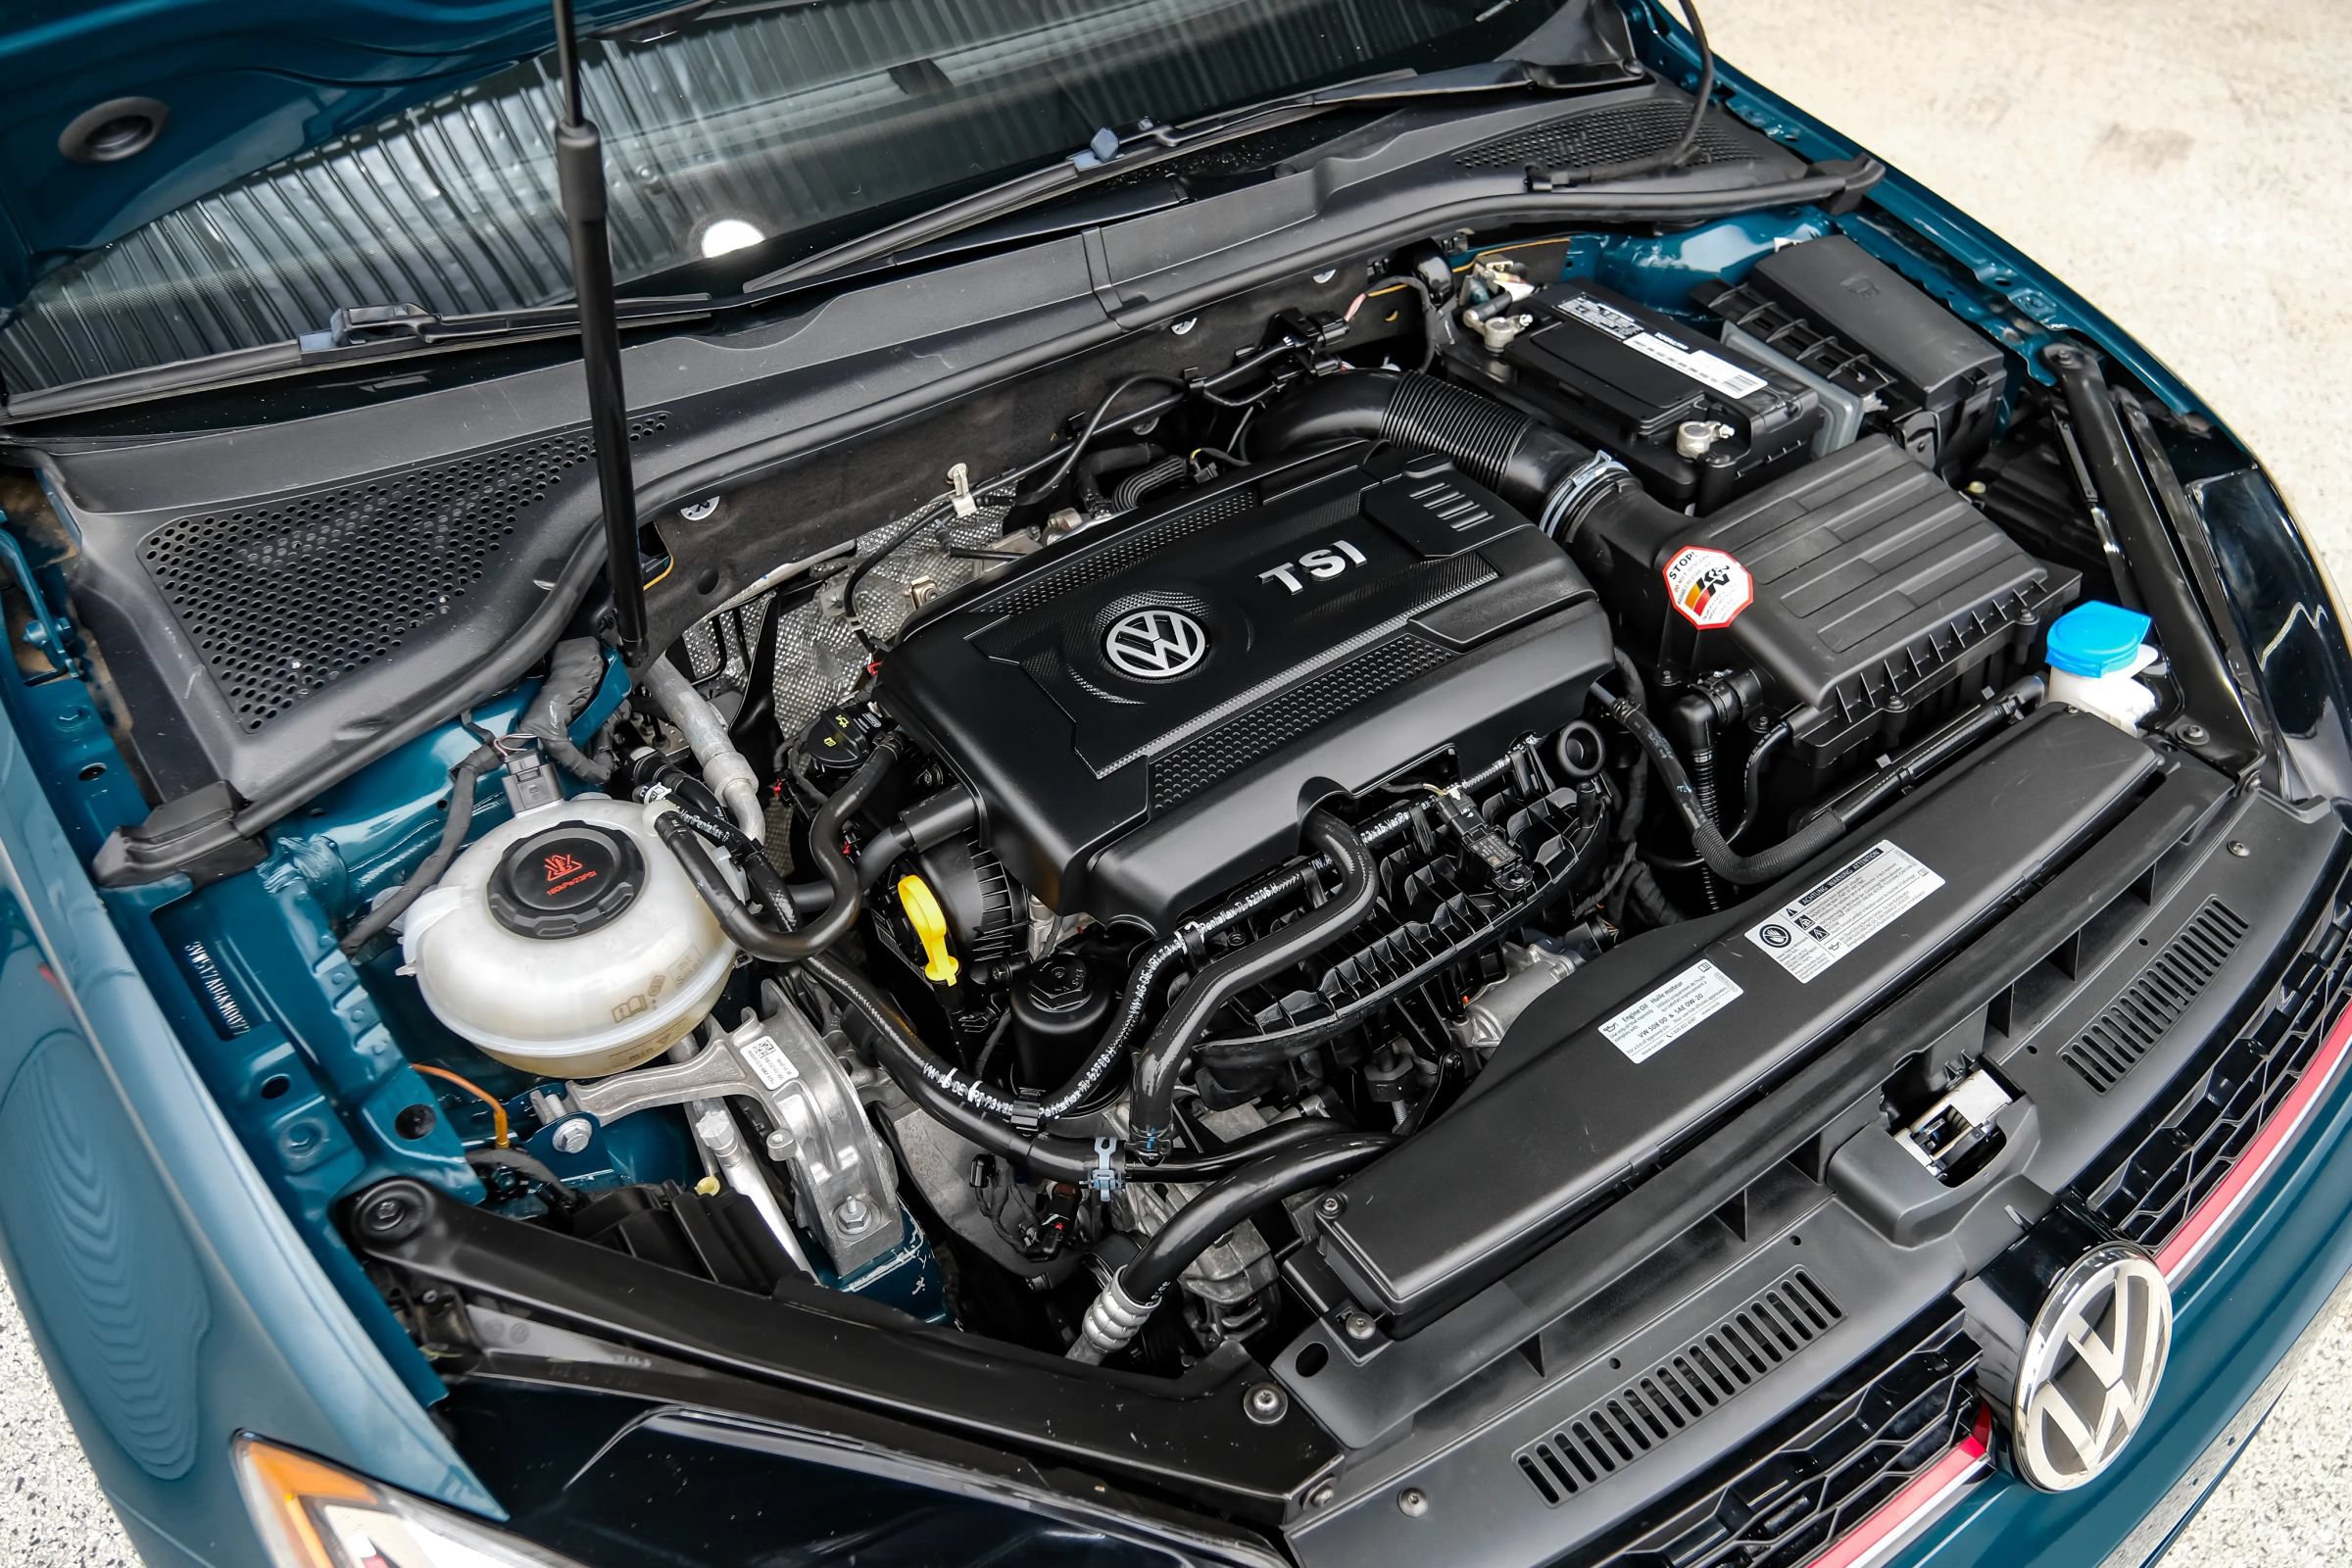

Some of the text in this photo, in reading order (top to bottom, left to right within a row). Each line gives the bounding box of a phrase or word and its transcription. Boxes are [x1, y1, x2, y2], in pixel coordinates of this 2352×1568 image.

[1255, 540, 1367, 595] TSI
[1669, 551, 1697, 580] STOP!
[1800, 885, 1828, 905] ACHTUNG
[1827, 867, 1853, 886] WARNING
[1851, 850, 1881, 869] ATTENTION
[1650, 981, 1683, 1004] Huile moteur
[1622, 1002, 1648, 1023] Engine Oil
[1638, 1029, 1649, 1038] VW
[1648, 1022, 1660, 1031] 508
[1658, 1015, 1669, 1025] 00
[1674, 1004, 1686, 1013] SAE
